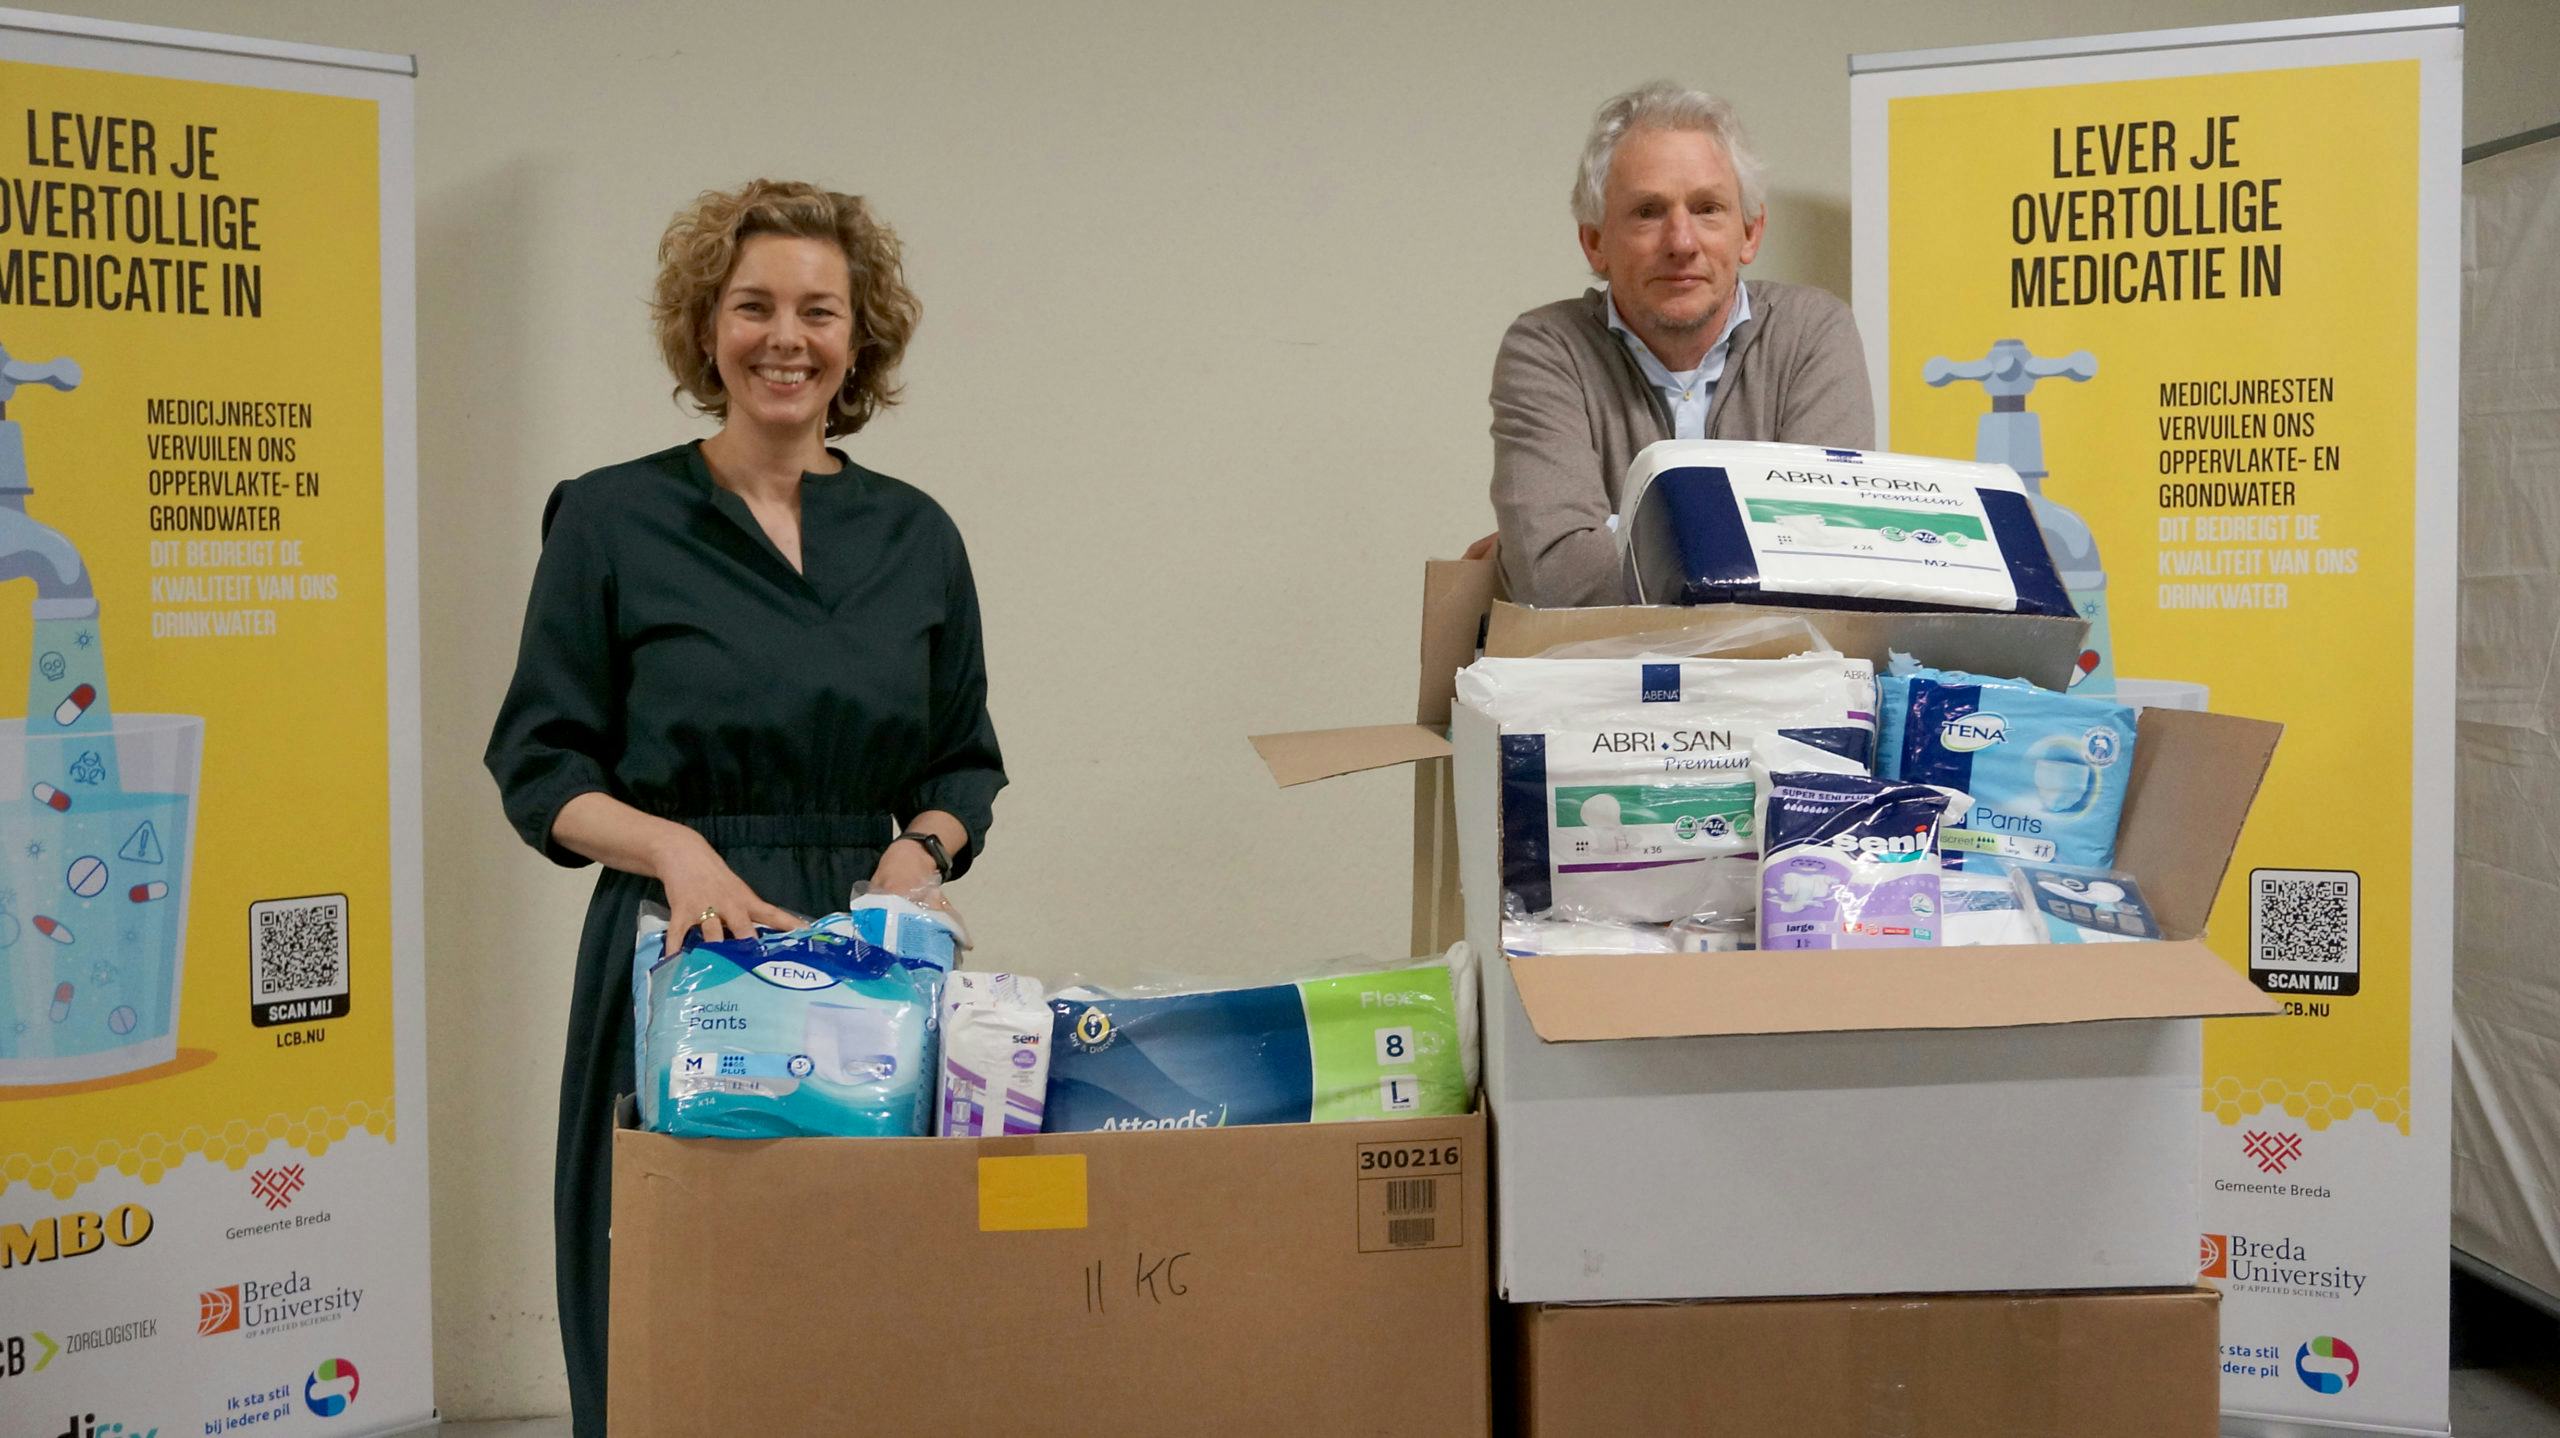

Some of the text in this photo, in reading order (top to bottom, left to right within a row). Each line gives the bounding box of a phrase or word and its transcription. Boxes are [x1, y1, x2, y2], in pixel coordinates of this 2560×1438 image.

[27, 109, 219, 181] LEVER JE
[2053, 115, 2240, 178] LEVER JE
[2011, 178, 2282, 245] OVERTOLLIGE
[0, 249, 261, 318] MEDICATIE IN
[2011, 244, 2282, 308] MEDICATIE IN
[2160, 377, 2334, 407] MEDICIJNRESTEN
[147, 399, 312, 428] MEDICIJNRESTEN
[2159, 412, 2315, 440] VERVUILEN ONS
[147, 434, 295, 462] VERVUILEN ONS
[2160, 446, 2339, 474] OPPERVLAKTE- EN
[149, 470, 319, 497] OPPERVLAKTE- EN
[1766, 469, 1941, 494] ABRI FORM
[2159, 481, 2295, 508] GRONDWATER
[1859, 489, 1964, 507] Premium
[150, 505, 280, 531] GRONDWATER
[2159, 514, 2320, 543] DIT BEDREIGT DE
[151, 540, 303, 568] DIT BEDREIGT DE
[1924, 559, 1948, 568] M2
[2158, 548, 2358, 577] KWALITEIT VAN ONS
[151, 574, 338, 602] KWALITEIT VAN ONS
[2158, 582, 2288, 609] DRINKWATER
[152, 610, 276, 638] DRINKWATER
[1643, 690, 1680, 701] ABENA
[1592, 730, 1731, 753] ABRI SAN
[1945, 722, 2006, 744] TENA
[1782, 788, 1815, 799] SUPER
[1818, 793, 1841, 801] SENI
[1976, 807, 2042, 834] Pants
[1651, 846, 1662, 854] 36
[1832, 825, 1928, 853] seni
[2009, 836, 2015, 846] L
[1786, 923, 1814, 933] large
[769, 965, 817, 982] TENA
[2268, 973, 2339, 991] SCAN MIJ
[269, 999, 333, 1021] SCAN MIJ
[1360, 990, 1409, 1008] Flex
[2284, 1002, 2330, 1017] CB.NU
[690, 1016, 747, 1030] Pants
[277, 1028, 325, 1048] LCB.NU
[1012, 1033, 1040, 1045] seni
[1386, 1034, 1404, 1057] 8
[686, 1056, 702, 1071] M
[1391, 1080, 1409, 1104] L
[1361, 1147, 1459, 1170] 300216
[2214, 1179, 2331, 1198] Gemeente Breda
[225, 1210, 331, 1241] Gemeente Breda
[2232, 1235, 2307, 1261] Breda
[244, 1270, 311, 1303] Breda
[1136, 1251, 1191, 1304] KG
[2232, 1259, 2367, 1296] University
[2233, 1283, 2340, 1299] OF APPLIED SCIENCES
[245, 1287, 363, 1327] University
[67, 1318, 158, 1354] ZORGLOGISTIEK
[260, 1323, 298, 1337] APPLIED
[300, 1313, 342, 1327] SCIENCES
[2229, 1345, 2251, 1357] sta
[2256, 1346, 2279, 1359] stil
[2220, 1361, 2279, 1379] dere pil
[227, 1385, 290, 1412] Ik sta stil
[205, 1405, 291, 1436] bij iedere pil
